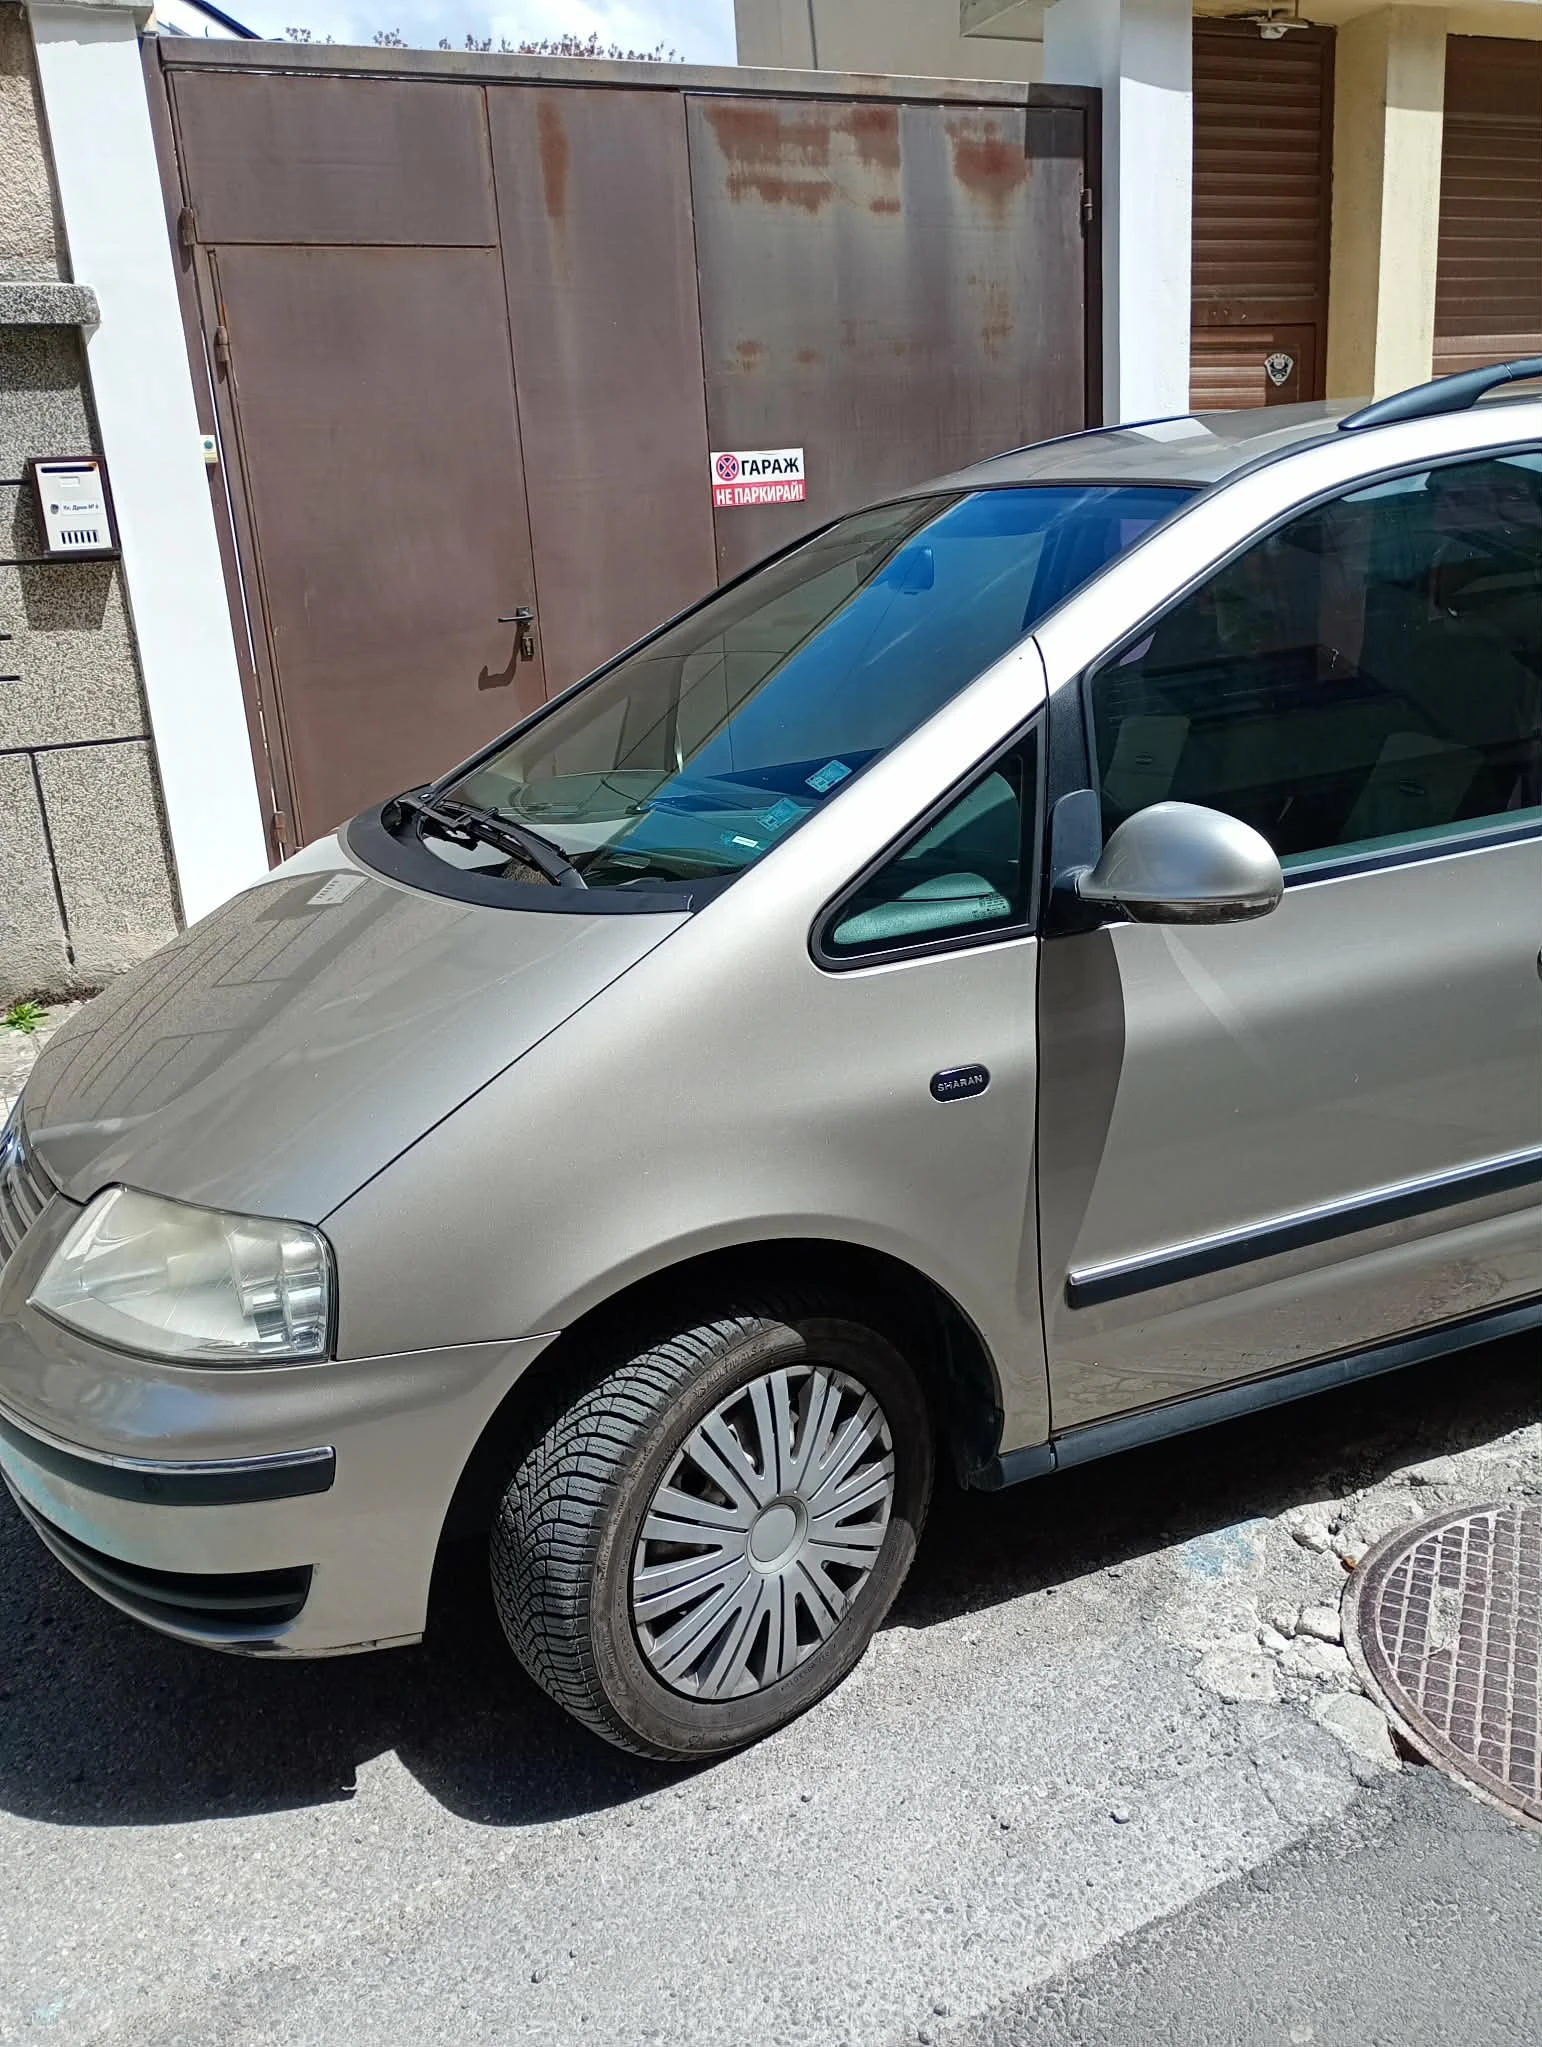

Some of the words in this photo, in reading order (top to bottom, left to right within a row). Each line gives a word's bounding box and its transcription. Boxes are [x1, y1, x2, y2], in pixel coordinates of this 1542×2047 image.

[741, 457, 799, 476] ГАРАЖ
[716, 488, 732, 505] НЕ
[734, 481, 803, 503] ПАРКИРАЙ!
[937, 1074, 983, 1092] SHARAN
